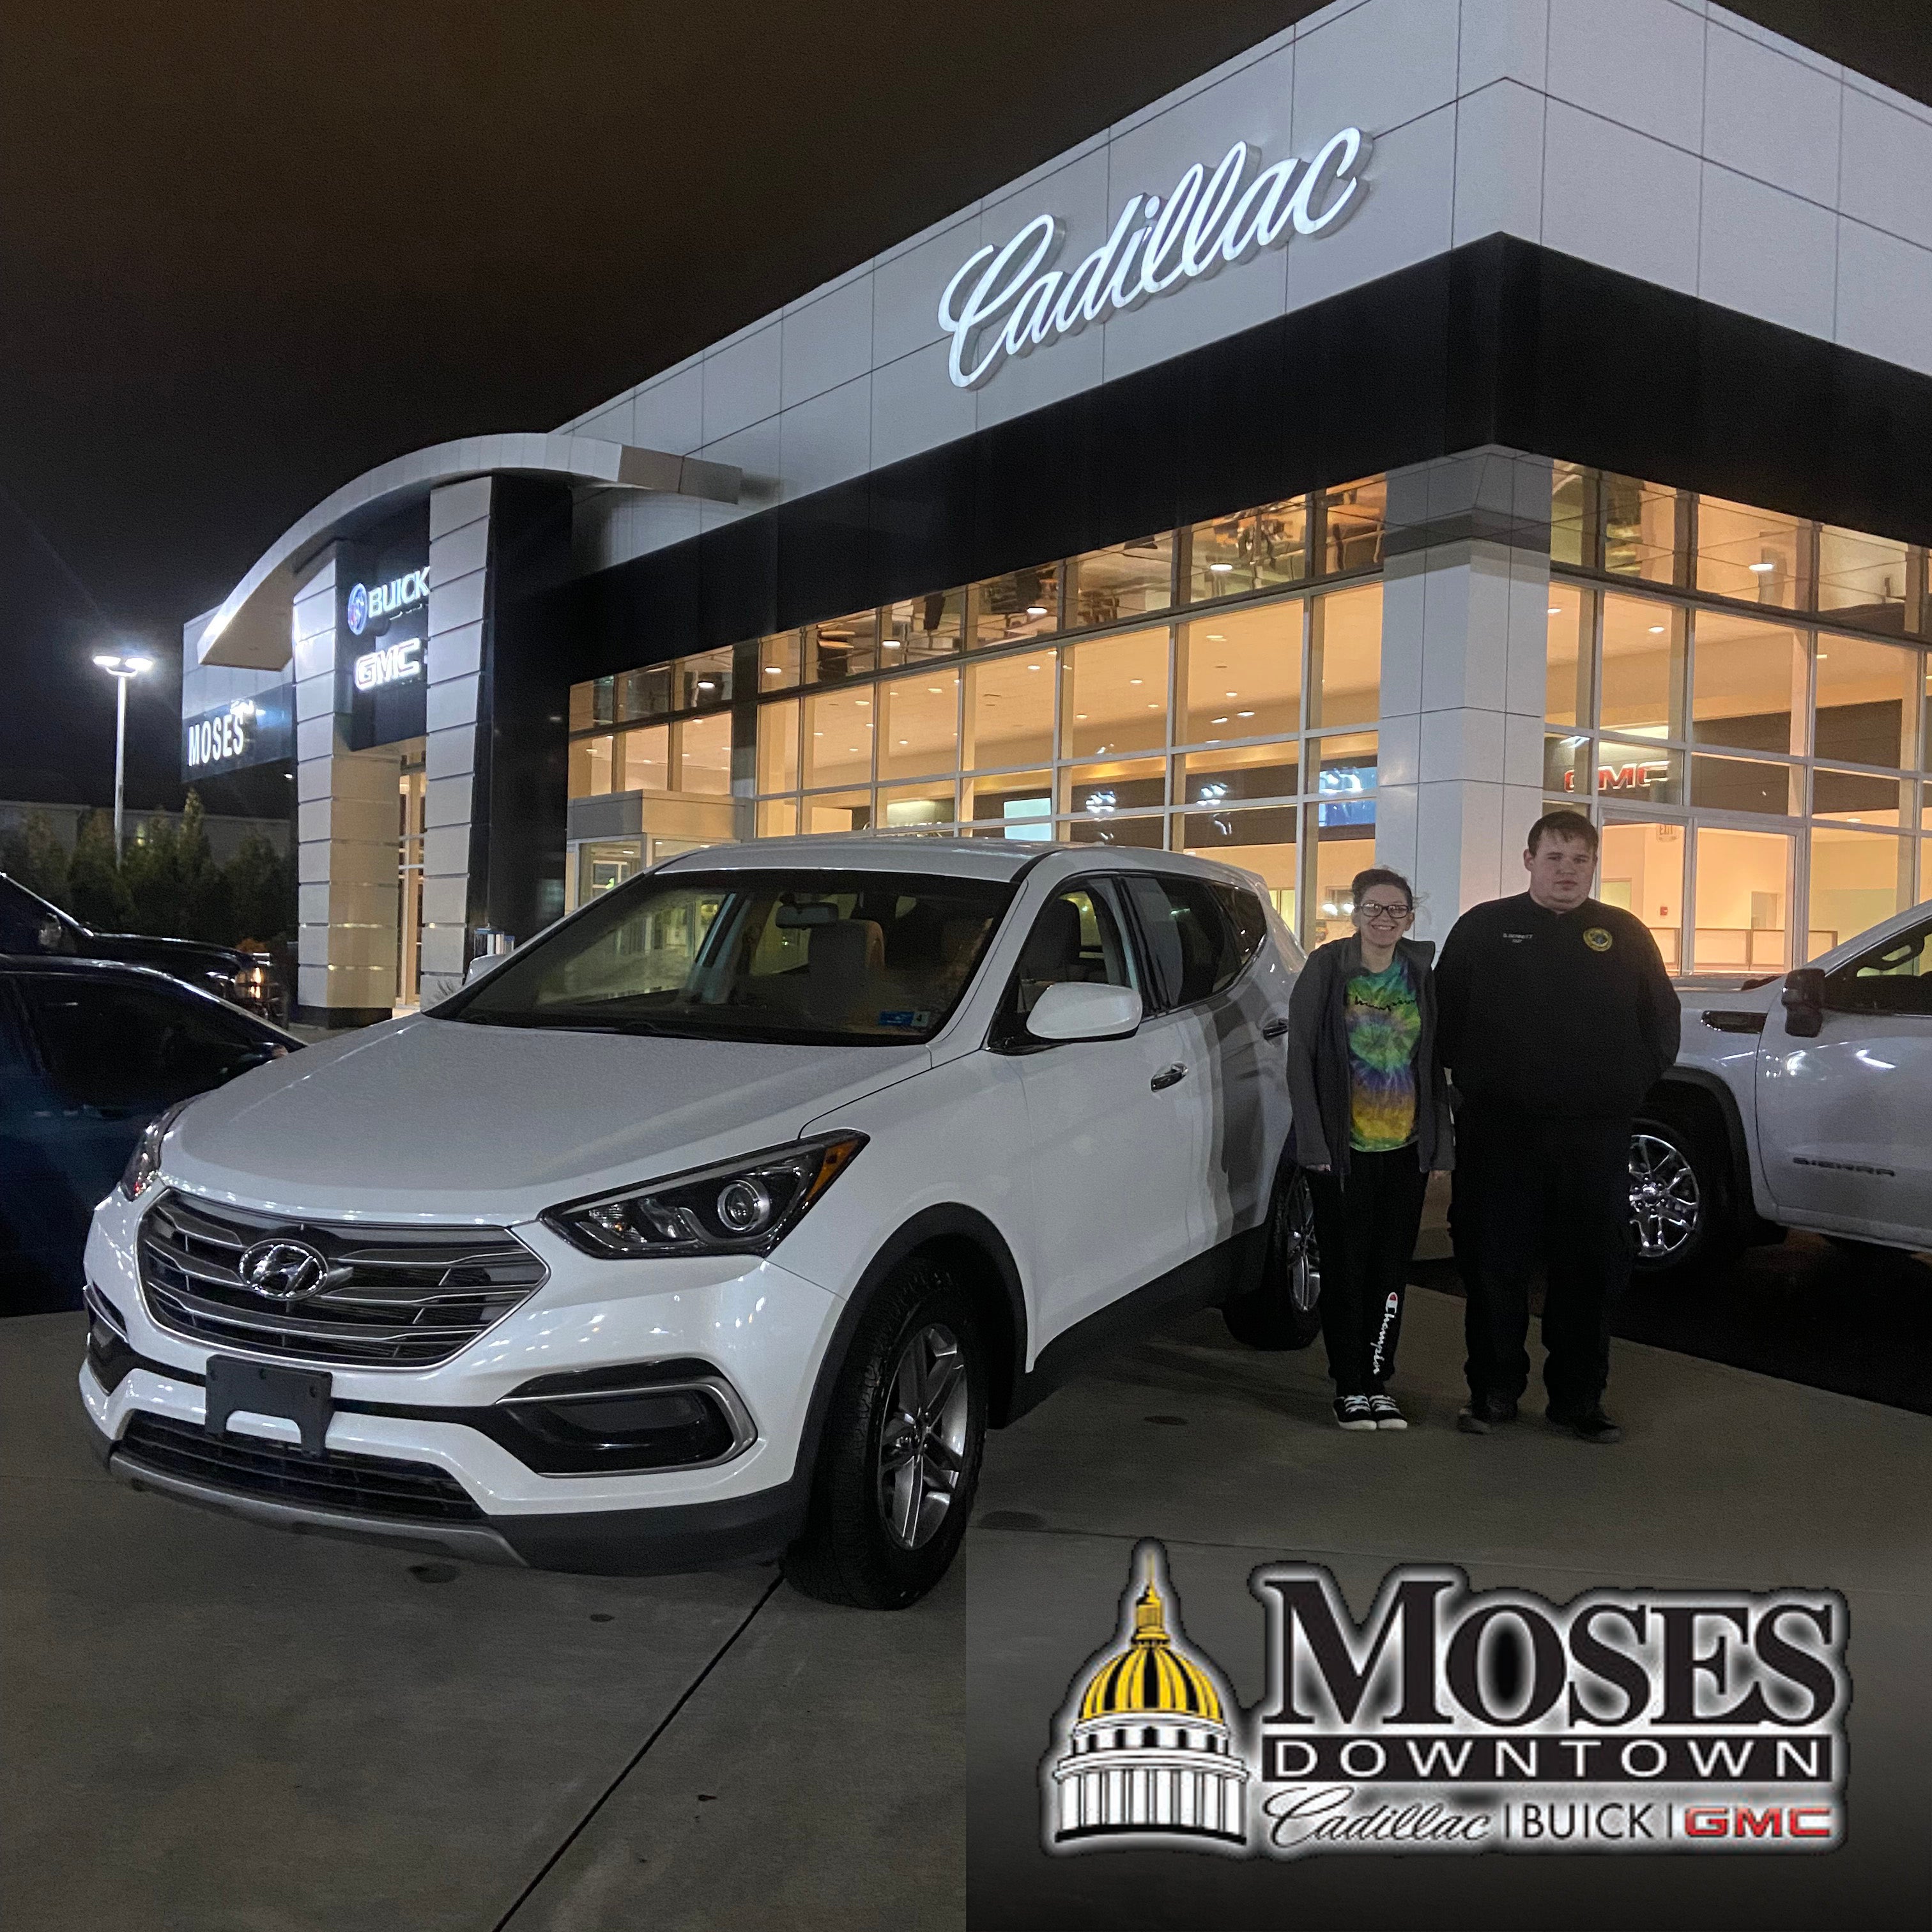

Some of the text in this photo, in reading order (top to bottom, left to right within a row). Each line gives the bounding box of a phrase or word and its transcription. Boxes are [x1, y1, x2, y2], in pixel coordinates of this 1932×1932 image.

[937, 127, 1361, 388] Cadillac
[368, 566, 431, 618] BUICK
[355, 638, 421, 691] GMC
[188, 714, 244, 767] MOSES
